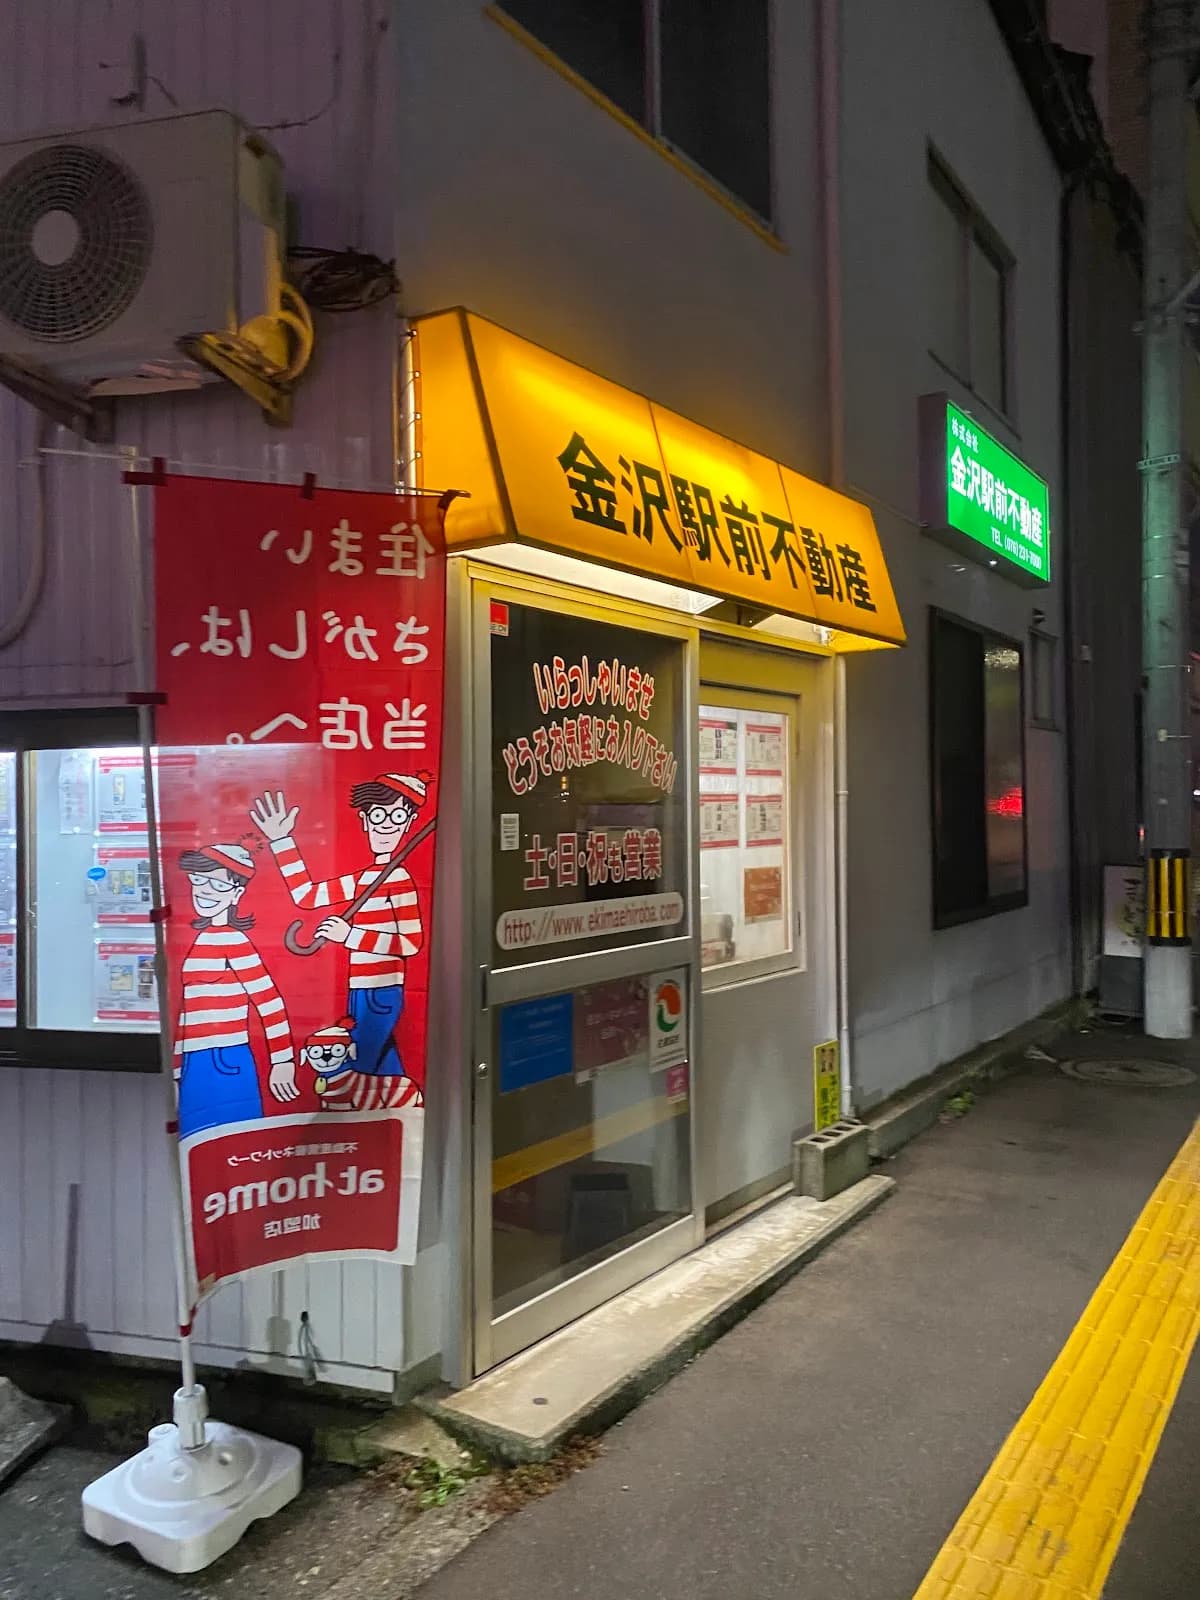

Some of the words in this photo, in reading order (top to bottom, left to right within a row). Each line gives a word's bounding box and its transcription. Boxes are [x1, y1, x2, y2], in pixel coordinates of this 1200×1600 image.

[557, 432, 877, 613] 金沢駅前不動産
[951, 445, 1043, 548] 金沢駅前不動産
[532, 655, 655, 720] いらっしゃいませ
